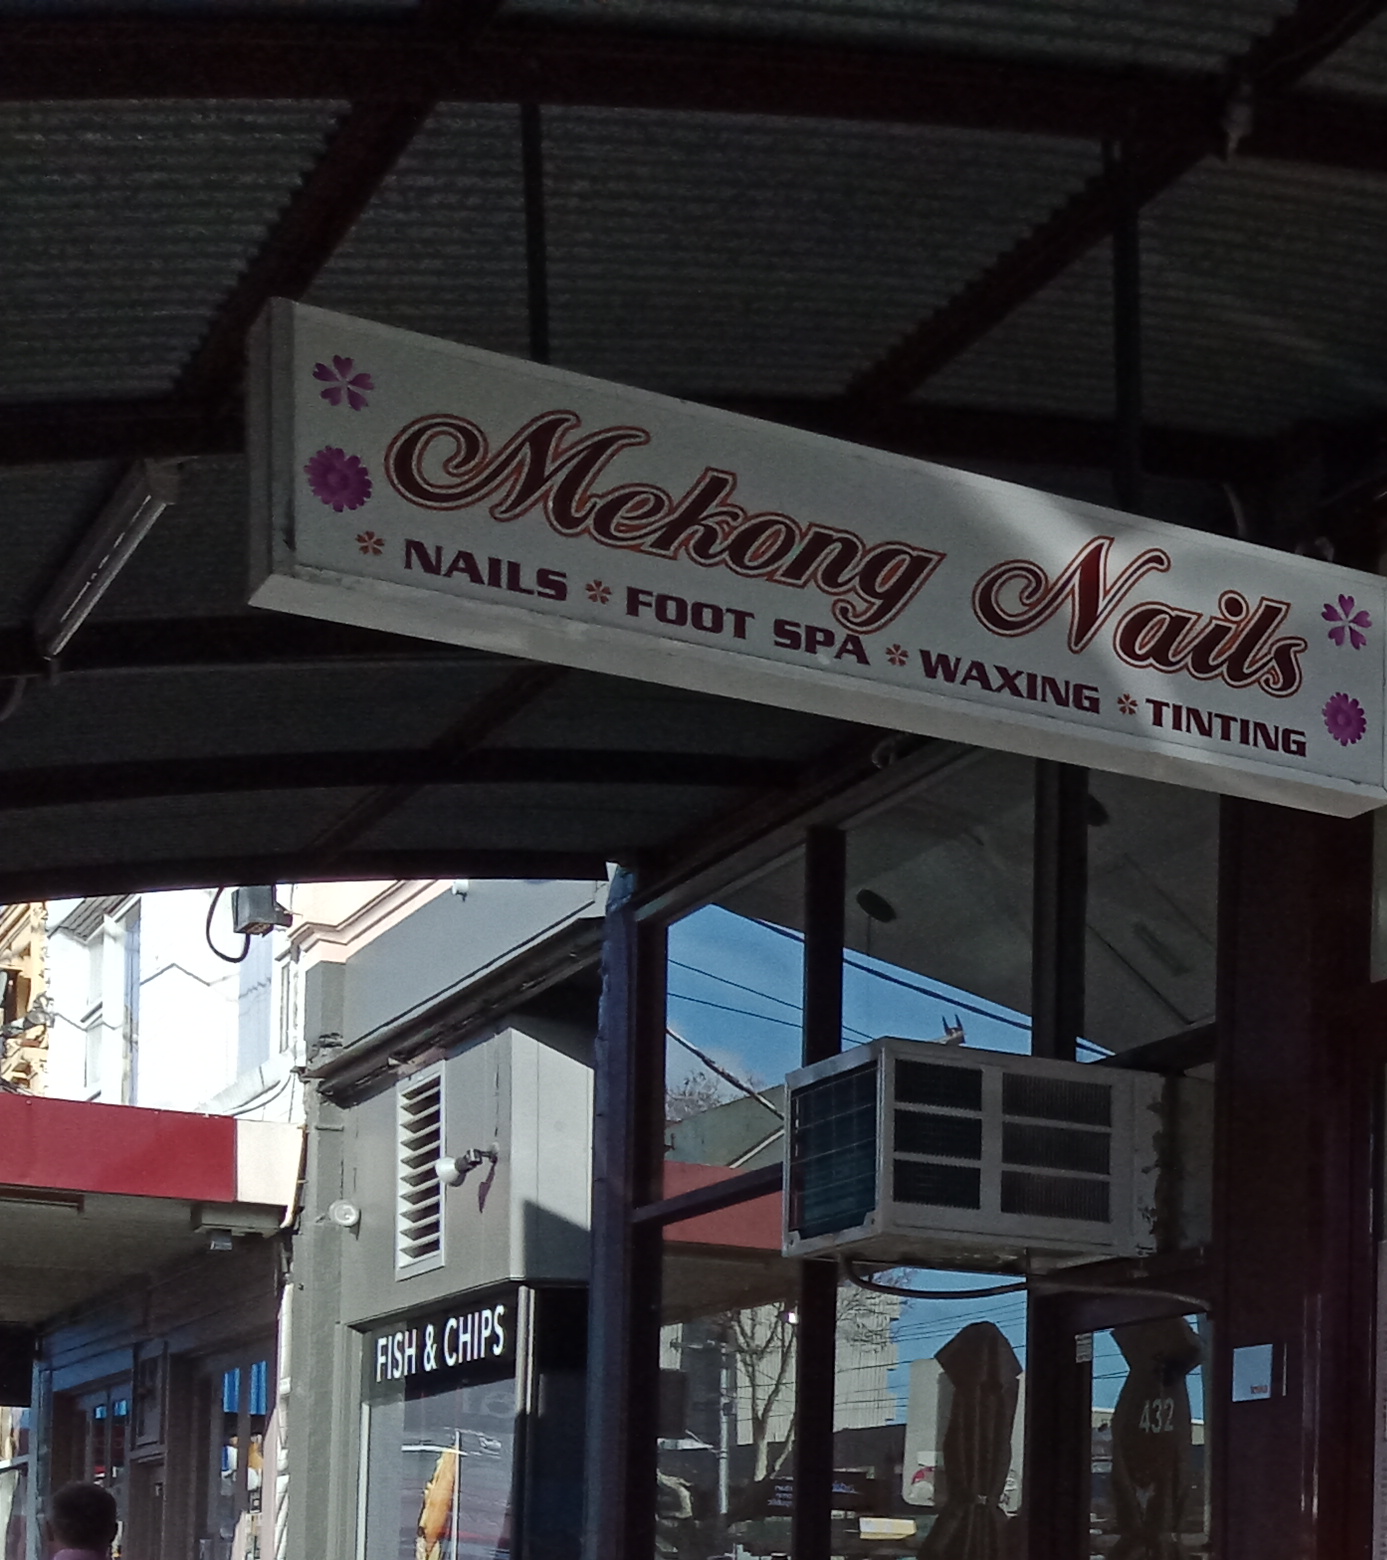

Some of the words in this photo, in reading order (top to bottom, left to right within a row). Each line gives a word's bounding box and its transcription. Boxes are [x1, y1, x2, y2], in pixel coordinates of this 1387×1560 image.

[384, 408, 946, 631] Mekong
[971, 535, 1309, 699] Nails
[404, 538, 568, 602] NAILS
[626, 586, 755, 643] FOOT
[771, 617, 871, 667] SPA
[919, 648, 1100, 715] WAXING
[1149, 697, 1307, 758] TINTING
[376, 1328, 417, 1383] FISH
[423, 1323, 438, 1372] &
[443, 1304, 506, 1366] CHIPS
[1139, 1398, 1175, 1434] 432
